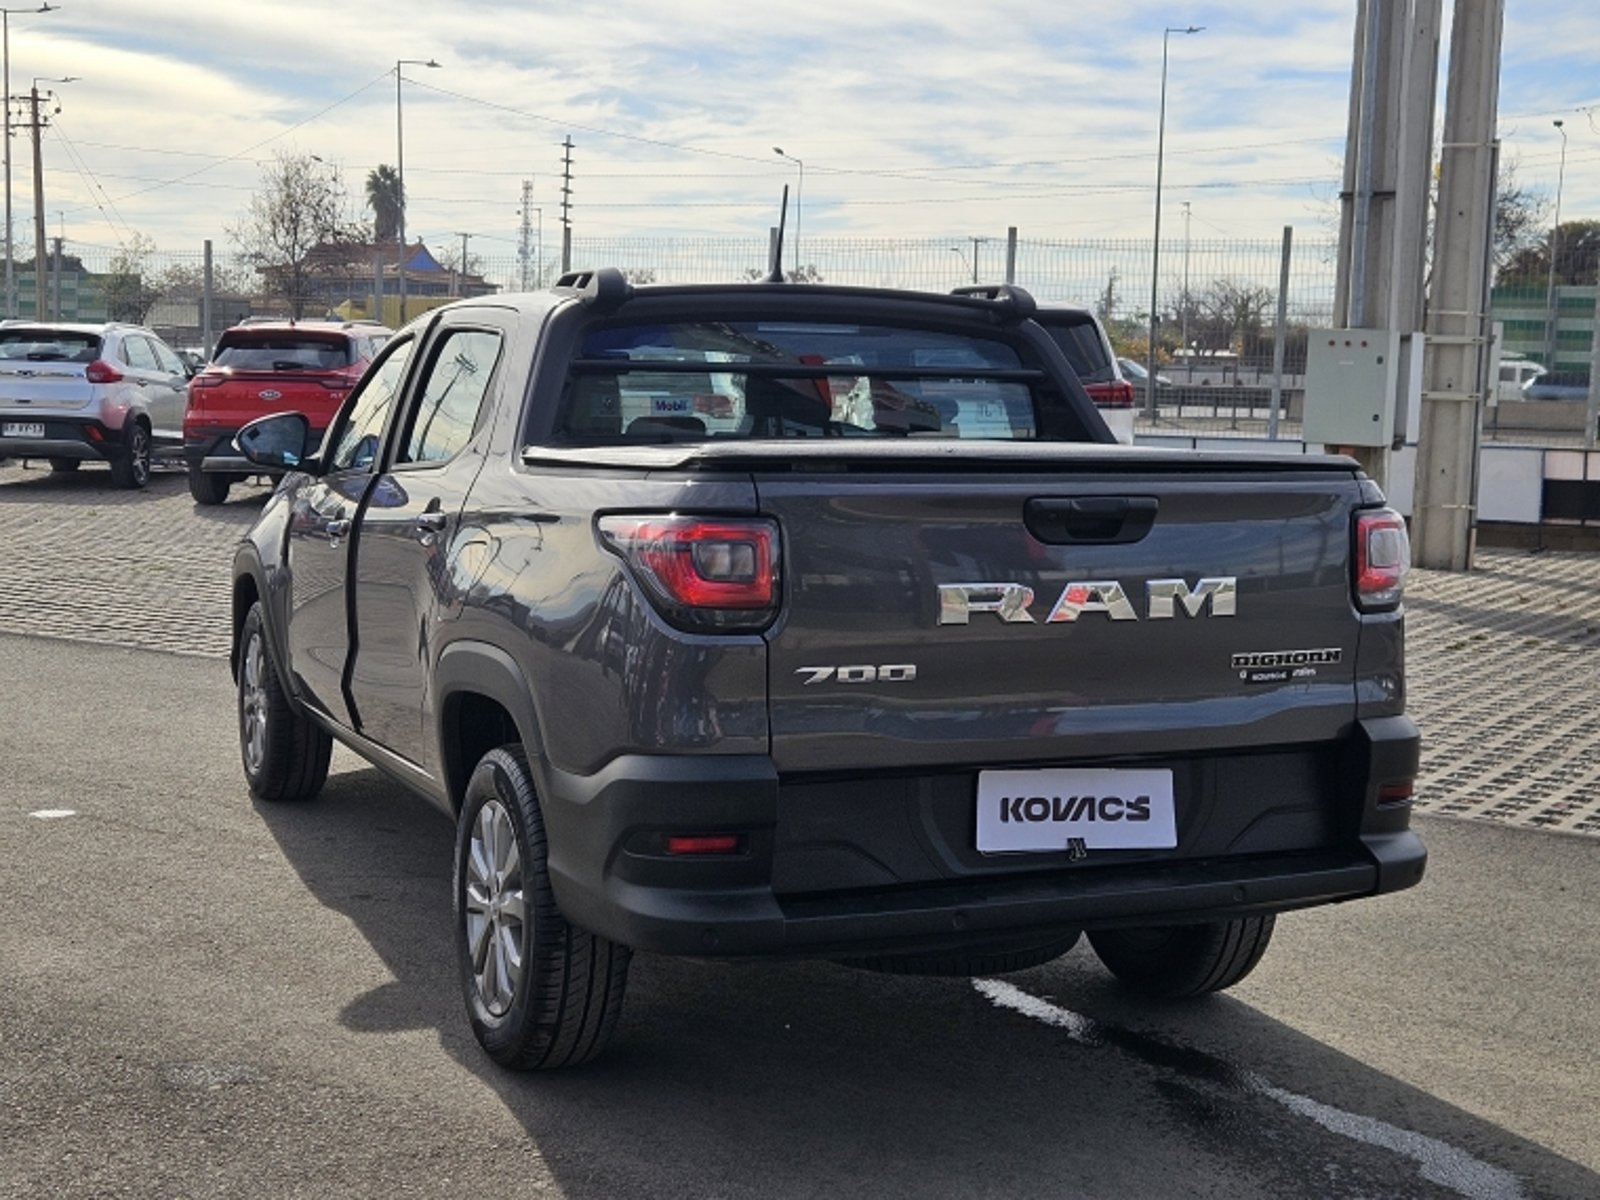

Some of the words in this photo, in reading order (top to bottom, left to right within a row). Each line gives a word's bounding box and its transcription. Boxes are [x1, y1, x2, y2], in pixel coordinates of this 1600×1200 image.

[655, 400, 687, 412] Mobil
[936, 577, 1237, 625] RAM
[795, 663, 917, 684] 700
[1000, 796, 1150, 823] KOVACS
